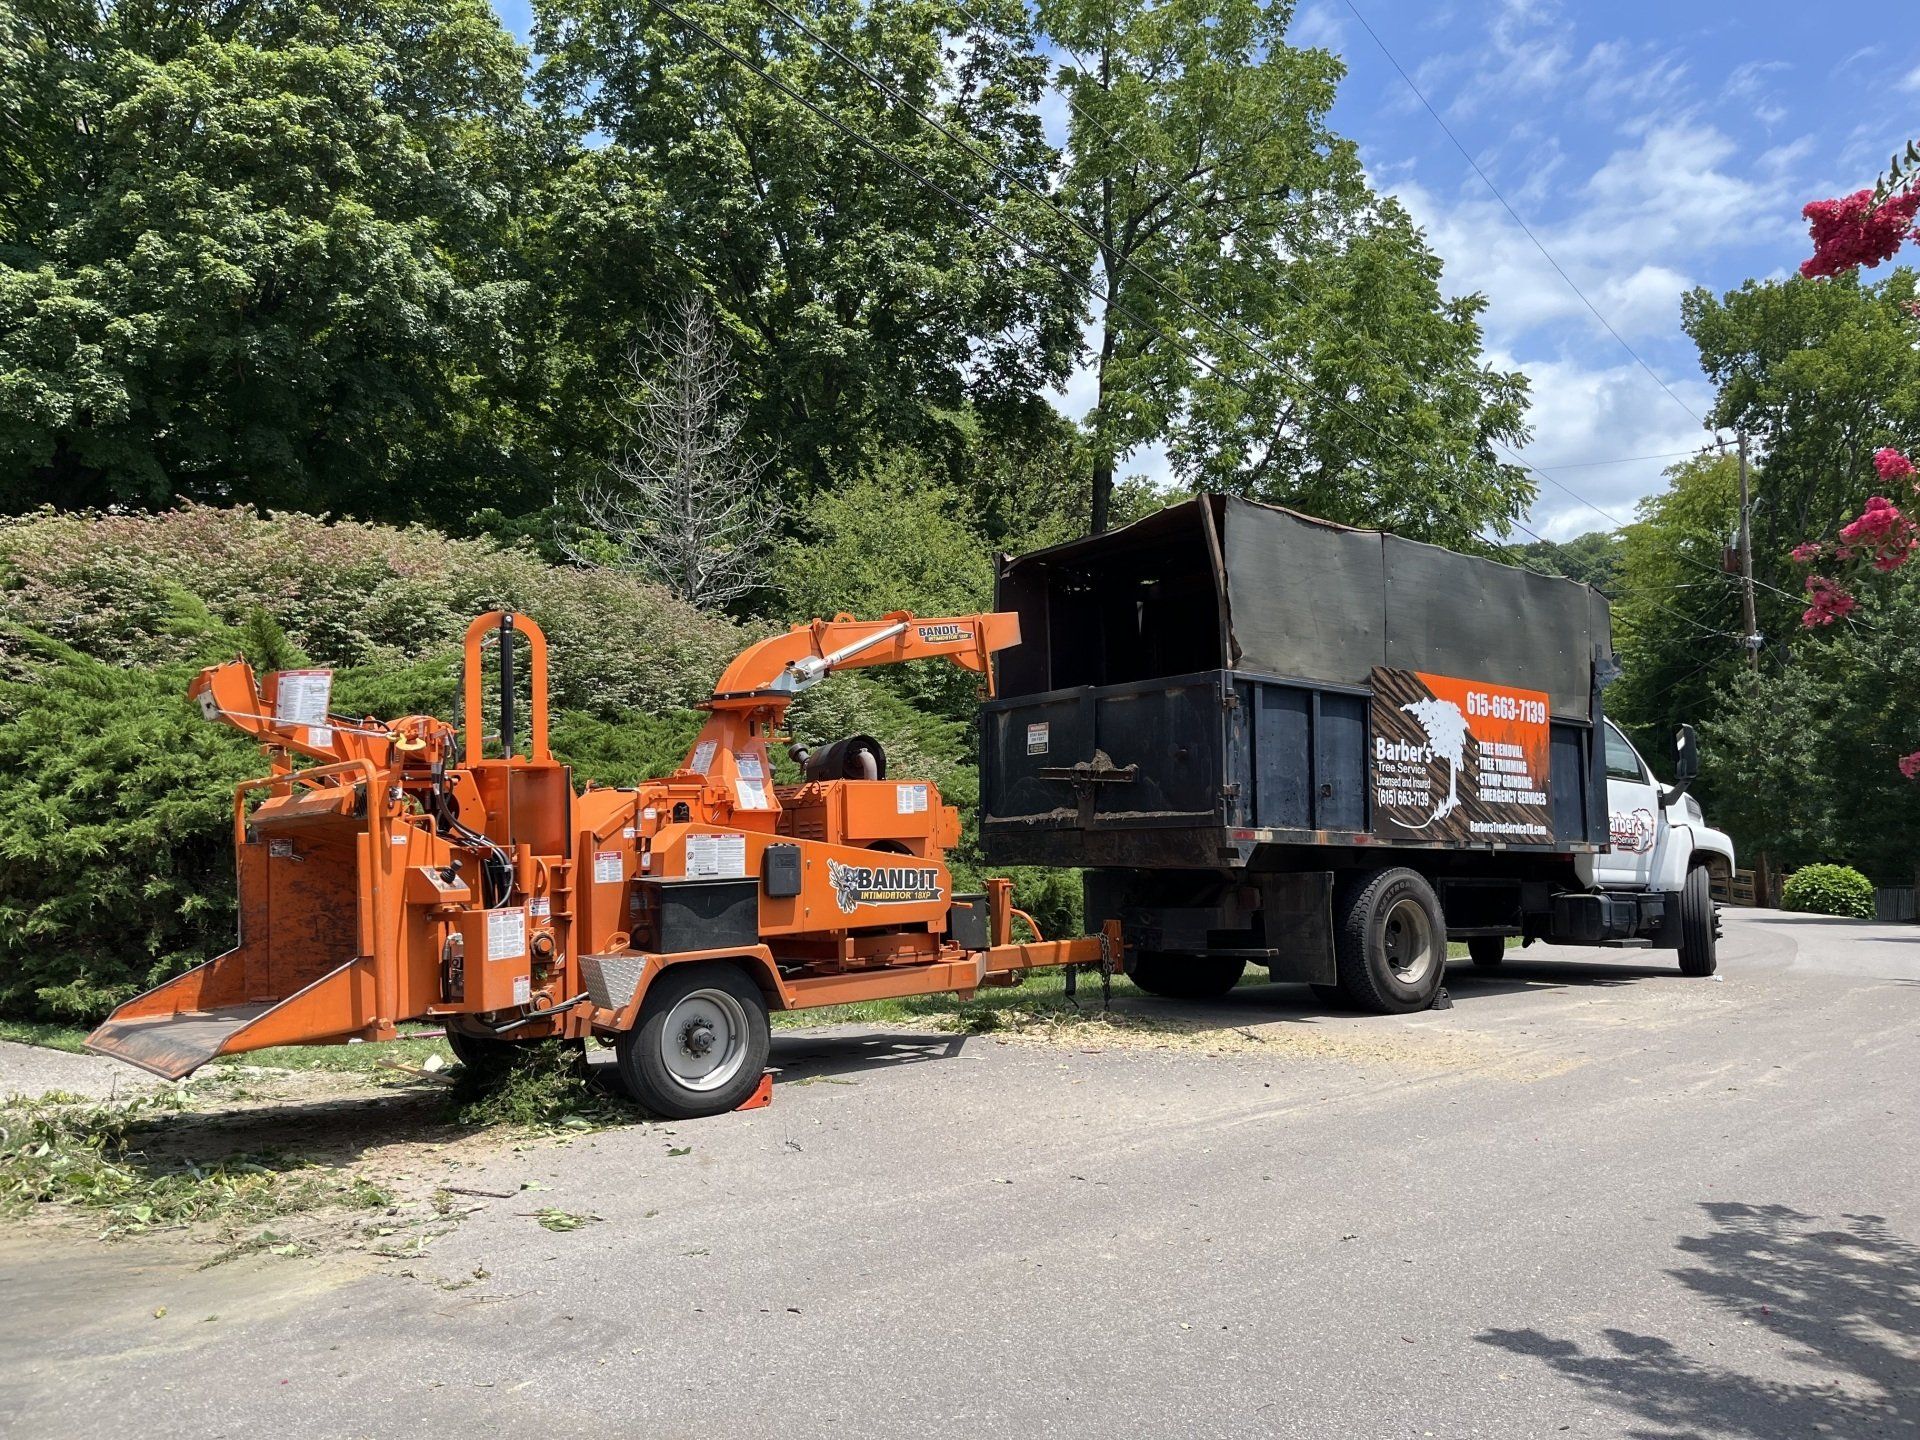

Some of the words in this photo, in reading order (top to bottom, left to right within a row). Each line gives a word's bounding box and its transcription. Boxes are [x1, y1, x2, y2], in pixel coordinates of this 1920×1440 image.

[918, 625, 959, 637] BANDIT
[1466, 691, 1546, 725] 615-663-7139
[1376, 737, 1432, 764] Barber's
[1479, 741, 1494, 756] TREE
[1494, 743, 1523, 758] REMOVAL
[1377, 761, 1396, 773] Tree
[1397, 762, 1427, 775] Service
[1479, 756, 1495, 771] TREE
[1495, 759, 1527, 774] TRIMMING
[1376, 773, 1401, 787] Licensed
[1402, 775, 1412, 788] and
[1412, 776, 1431, 789] Insured
[1480, 772, 1502, 787] STUMP
[1502, 775, 1532, 789] GRINDING
[1377, 787, 1396, 808] (615)
[1397, 790, 1429, 807] 663-7139
[1480, 788, 1517, 803] EMERGENCY
[1517, 790, 1547, 805] SERVICES
[1609, 811, 1643, 835] arber's
[857, 868, 938, 890] BANDIT
[860, 891, 911, 900] INTIMIDATOR
